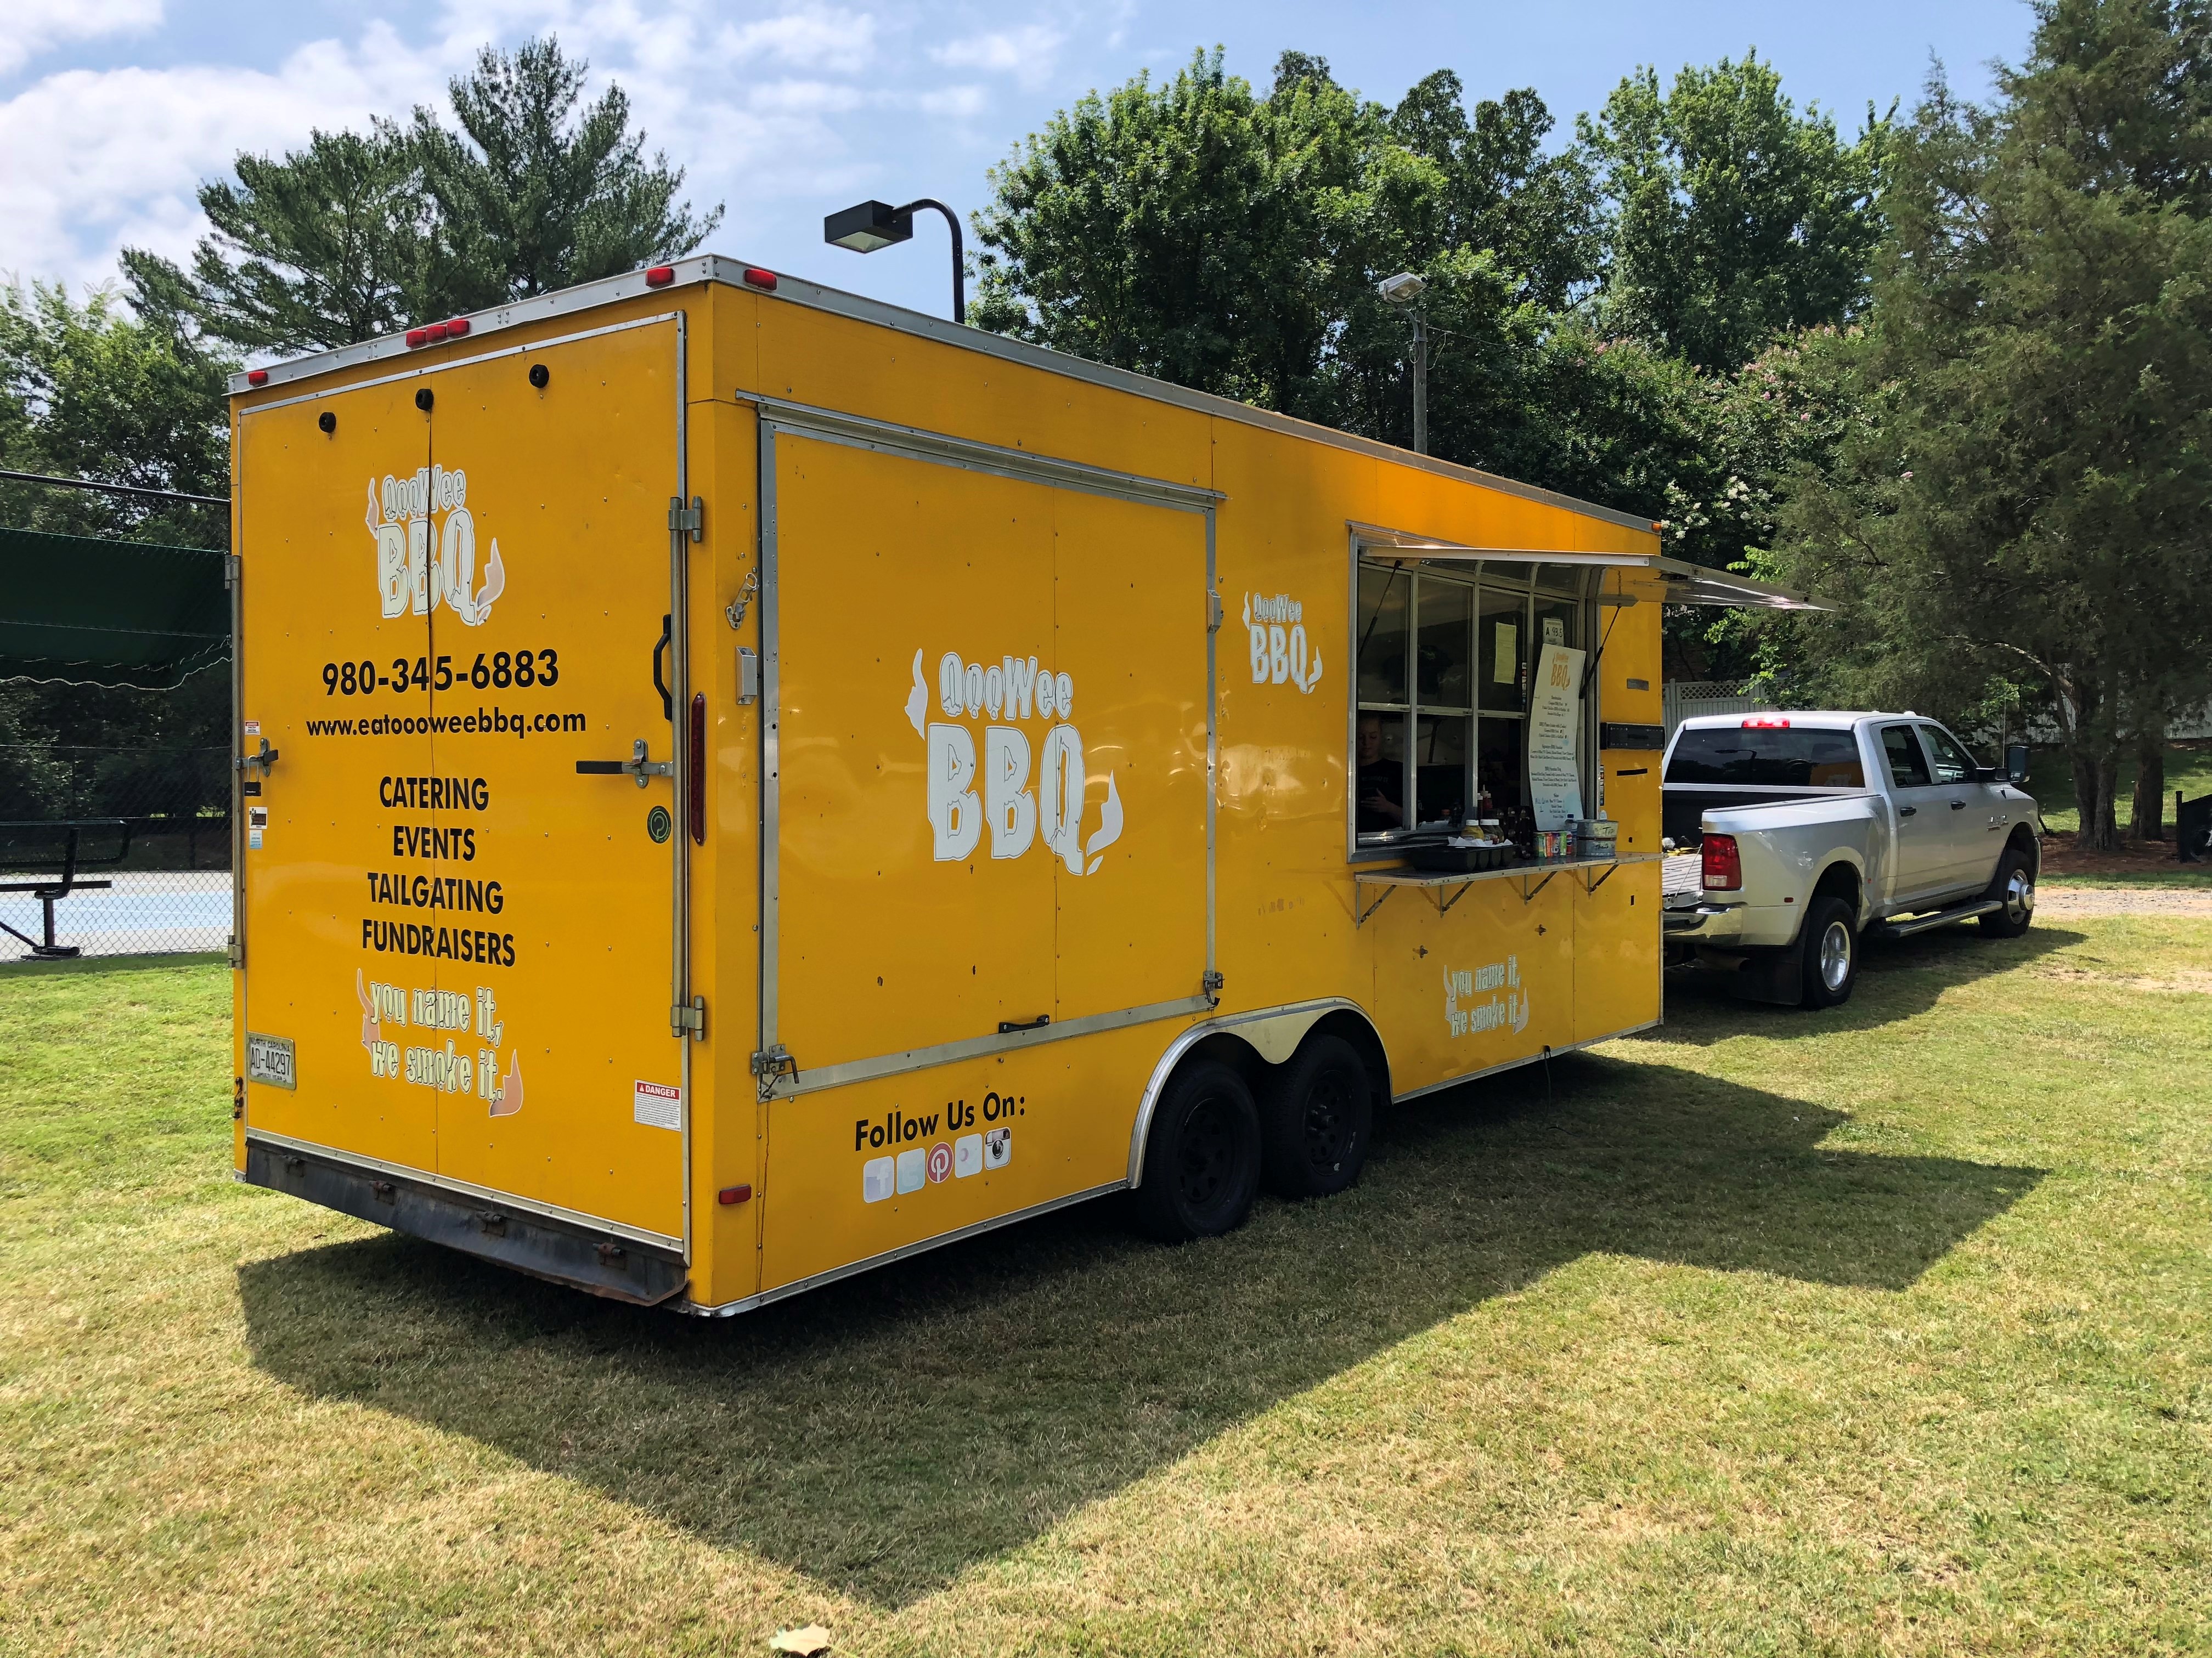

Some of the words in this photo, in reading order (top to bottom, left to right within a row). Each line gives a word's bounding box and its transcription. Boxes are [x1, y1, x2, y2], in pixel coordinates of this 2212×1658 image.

[377, 507, 476, 626] BBQ
[323, 649, 559, 695] 980-345-6883
[1250, 624, 1308, 694] BBQ
[306, 707, 586, 739] www.eatoooweebbq.com
[380, 776, 489, 811] CATERING
[928, 722, 1085, 876] BBQ
[393, 825, 476, 861] EVENTS
[368, 872, 504, 914] TAILGATING
[363, 919, 515, 967] FUNDRAISERS
[1452, 971, 1472, 1003] you
[1475, 963, 1504, 992] name
[370, 981, 407, 1027] you
[412, 989, 470, 1031] name
[477, 987, 504, 1047] it,
[405, 1039, 472, 1093] smoke
[478, 1048, 503, 1103] it.
[645, 1085, 676, 1098] DANGER
[855, 1111, 939, 1152] Follow
[947, 1100, 975, 1131] Us
[983, 1092, 1025, 1122] On:
